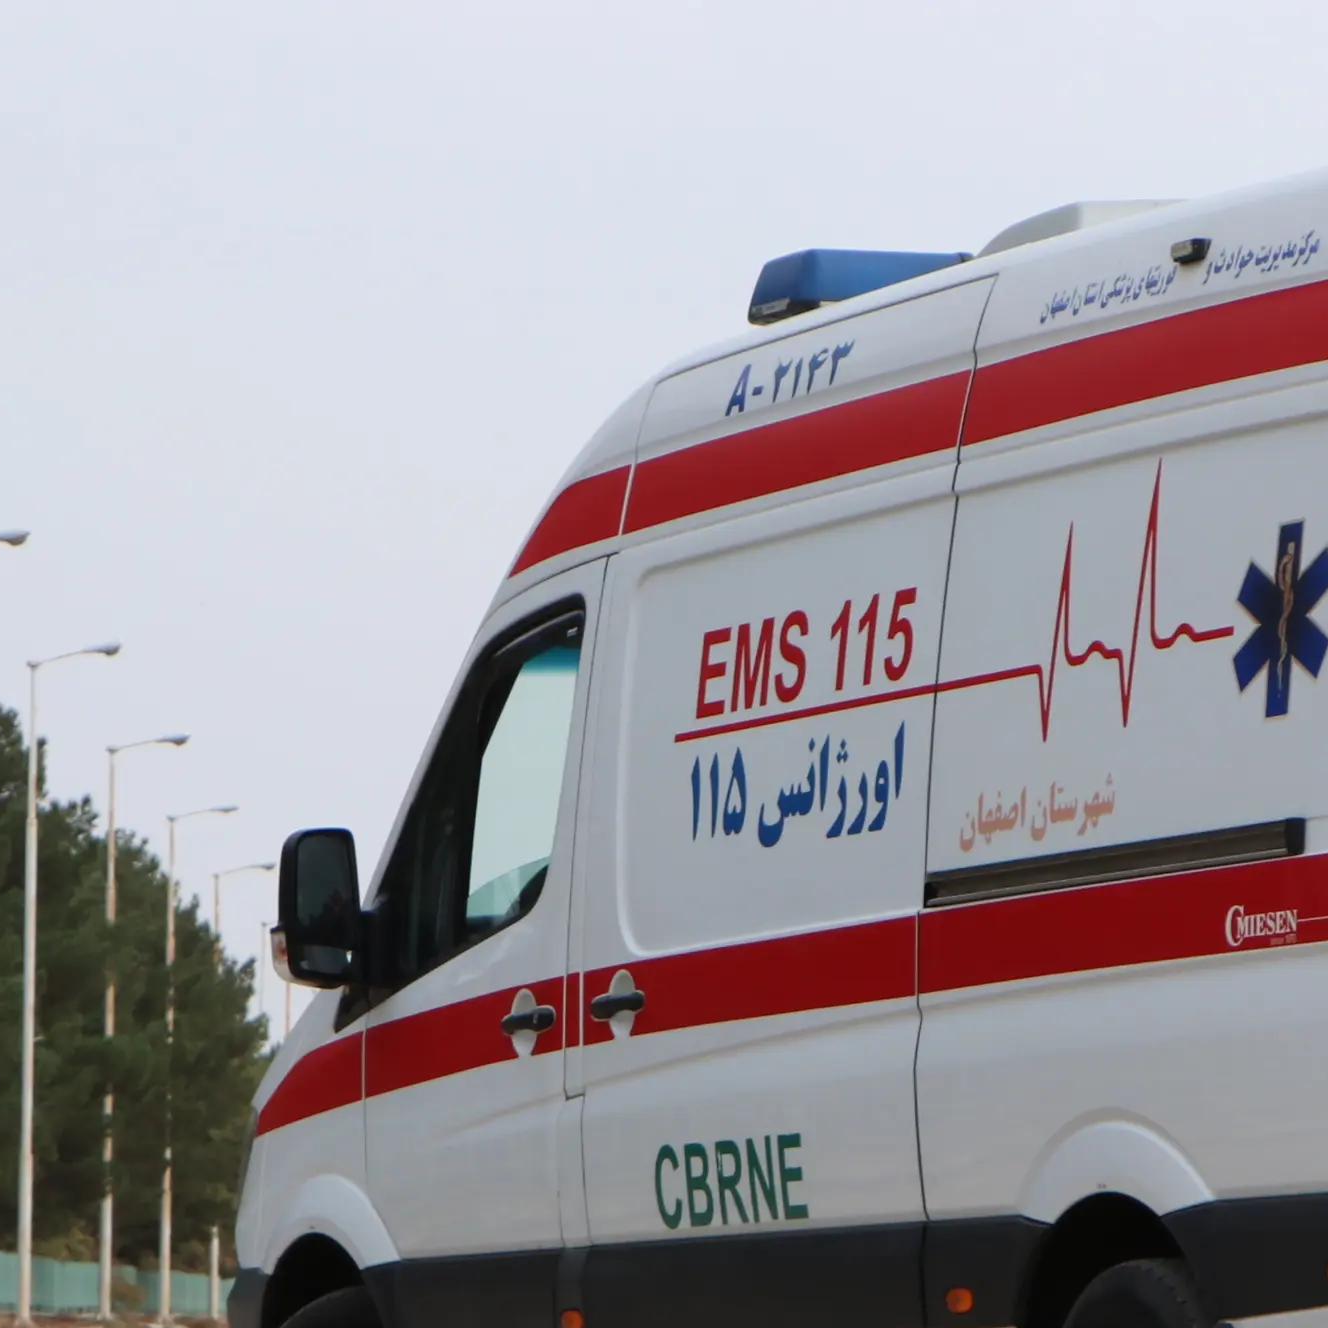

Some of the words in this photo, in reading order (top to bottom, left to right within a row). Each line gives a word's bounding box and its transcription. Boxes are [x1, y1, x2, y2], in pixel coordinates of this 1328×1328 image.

[1202, 260, 1213, 285] و
[1213, 245, 1255, 279] حوادث
[1254, 240, 1297, 273] مدیریت
[1291, 229, 1321, 268] مرکز
[1039, 286, 1078, 325] اصفهان
[1071, 279, 1106, 317] استان
[695, 609, 810, 720] EMS
[830, 586, 918, 692] 115
[690, 746, 747, 842] ۱۱۵
[757, 718, 906, 848] اورژانس
[1030, 771, 1116, 842] شهرستان
[959, 785, 1027, 853] اصفهان
[654, 1132, 810, 1230] CBRNE
